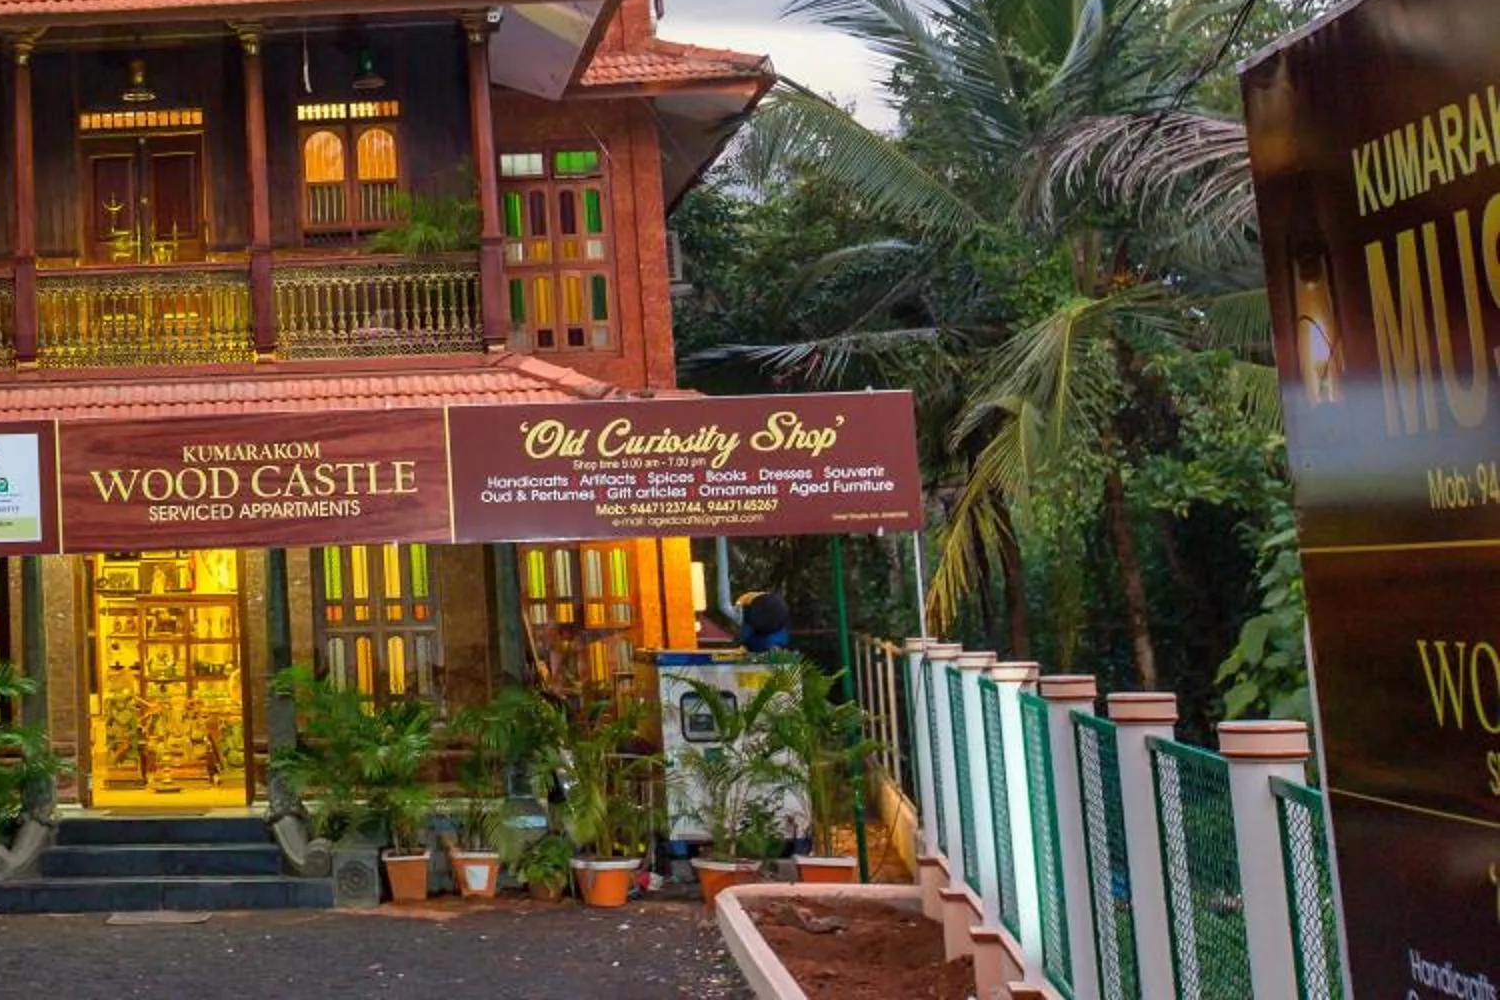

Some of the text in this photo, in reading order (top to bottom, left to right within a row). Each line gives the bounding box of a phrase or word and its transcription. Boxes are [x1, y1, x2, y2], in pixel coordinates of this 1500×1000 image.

[182, 441, 321, 463] KUMARAKOM
[596, 417, 740, 469] Curiosity
[90, 461, 419, 503] WOOD CASTLE
[487, 465, 886, 489] Handicrafts Artifacts Spices Books Dresses Souvenir
[1427, 468, 1475, 509] Mob:
[481, 478, 895, 503] Oud & Perfumes Gift articles Ornaments Aged Furniture
[149, 500, 361, 521] SERVICED APPARTMENTS
[595, 502, 626, 516] Mob:
